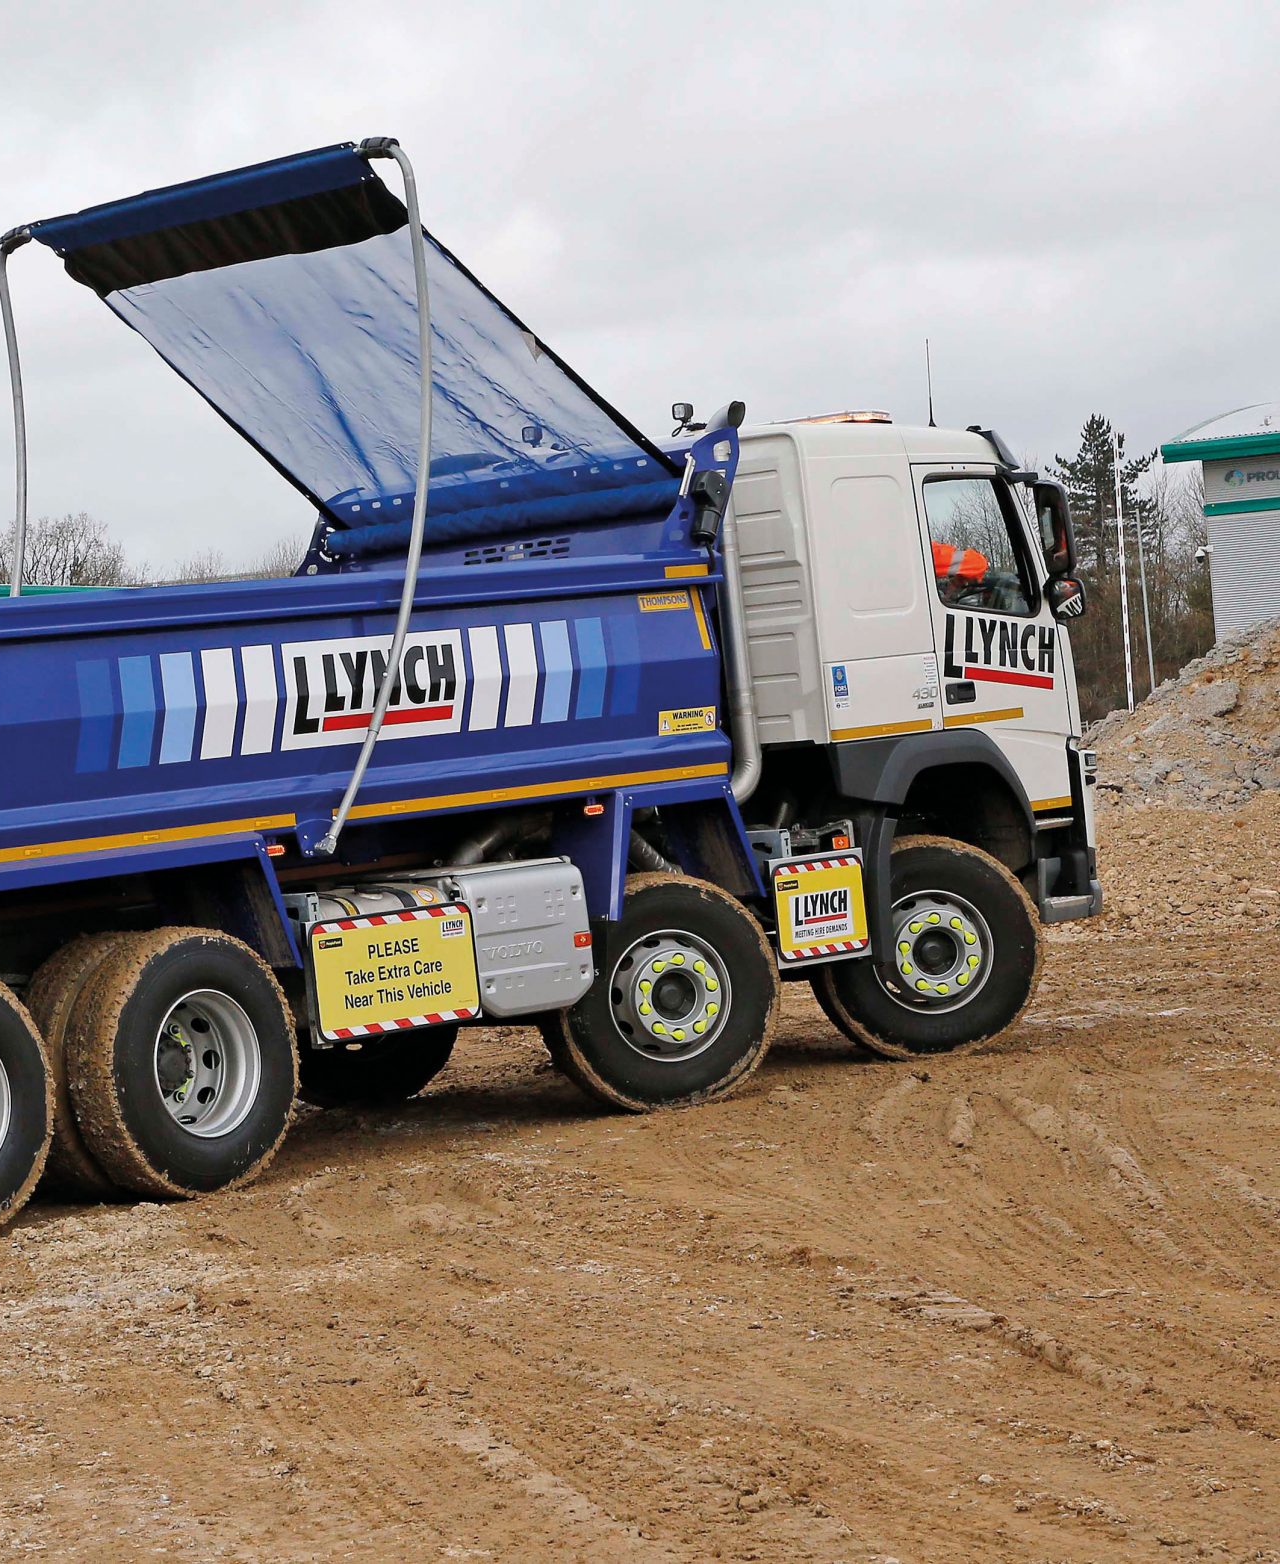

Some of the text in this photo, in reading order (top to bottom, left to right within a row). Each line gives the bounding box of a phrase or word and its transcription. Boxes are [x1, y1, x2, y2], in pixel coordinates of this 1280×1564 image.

[639, 594, 687, 609] THOMPSONS
[912, 686, 938, 700] 430
[672, 710, 704, 720] WARNING
[795, 923, 848, 938] MEETING HIRE DEMANDS
[368, 938, 420, 959] PLEASE
[481, 940, 542, 960] VOLVO
[345, 960, 443, 986] Take Extra Care
[345, 979, 452, 1009] Near This Vehicle
